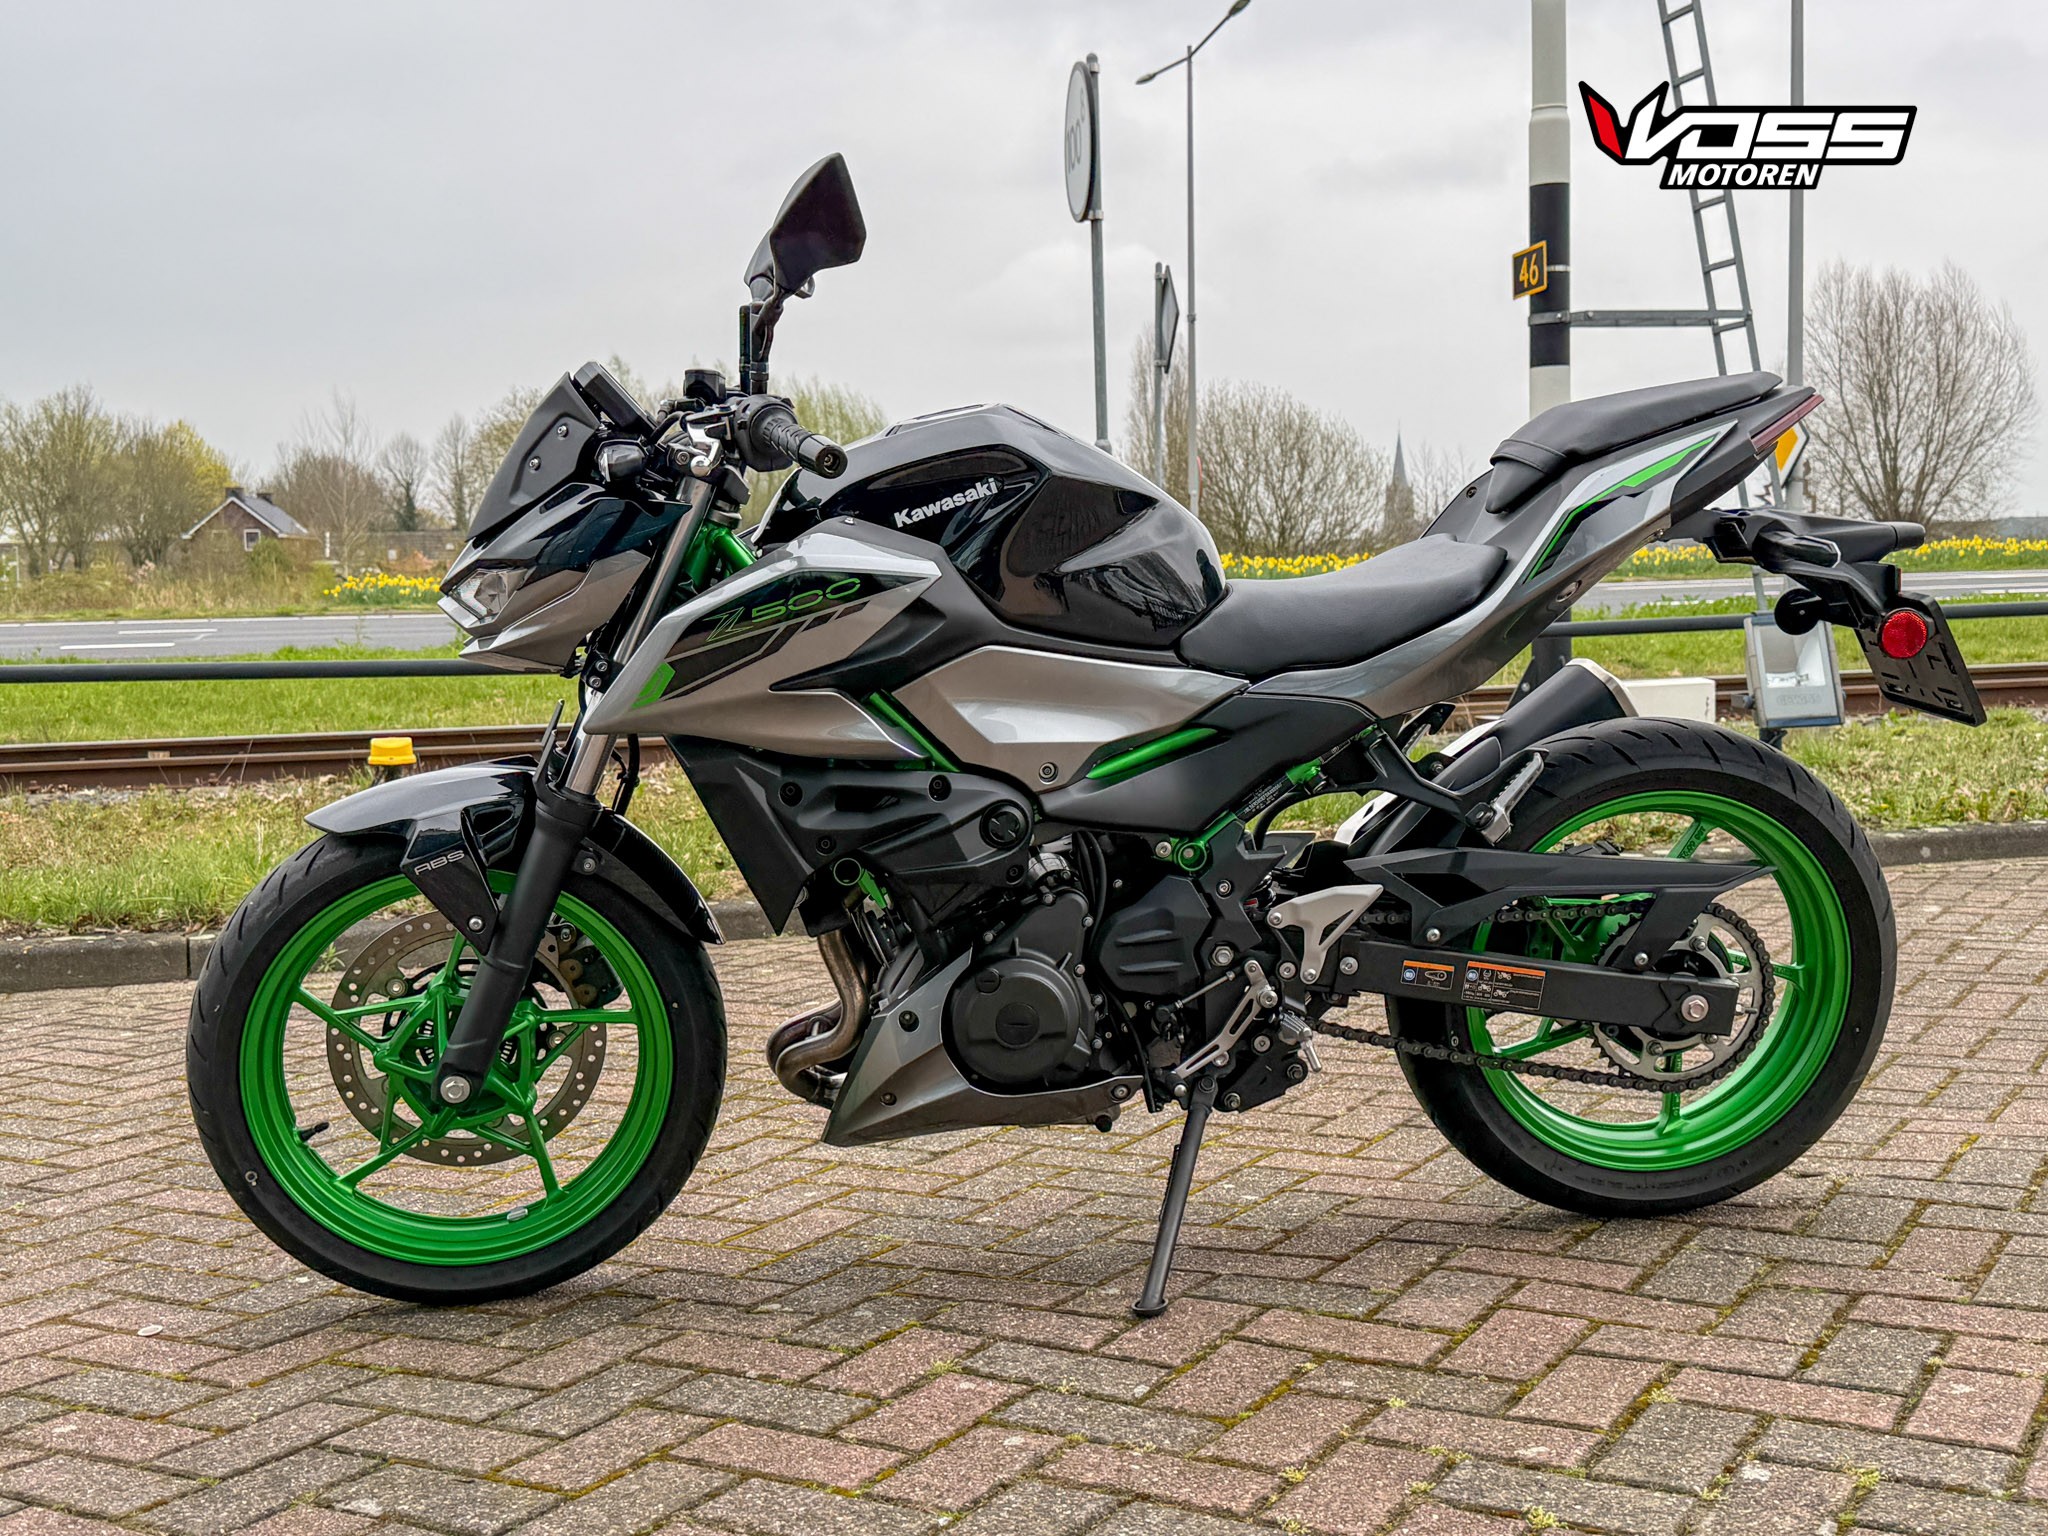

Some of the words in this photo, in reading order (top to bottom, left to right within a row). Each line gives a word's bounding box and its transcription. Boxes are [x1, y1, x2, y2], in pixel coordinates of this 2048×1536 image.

[1519, 253, 1539, 288] 46
[894, 477, 999, 528] Kawasaki
[414, 850, 465, 876] ABS
